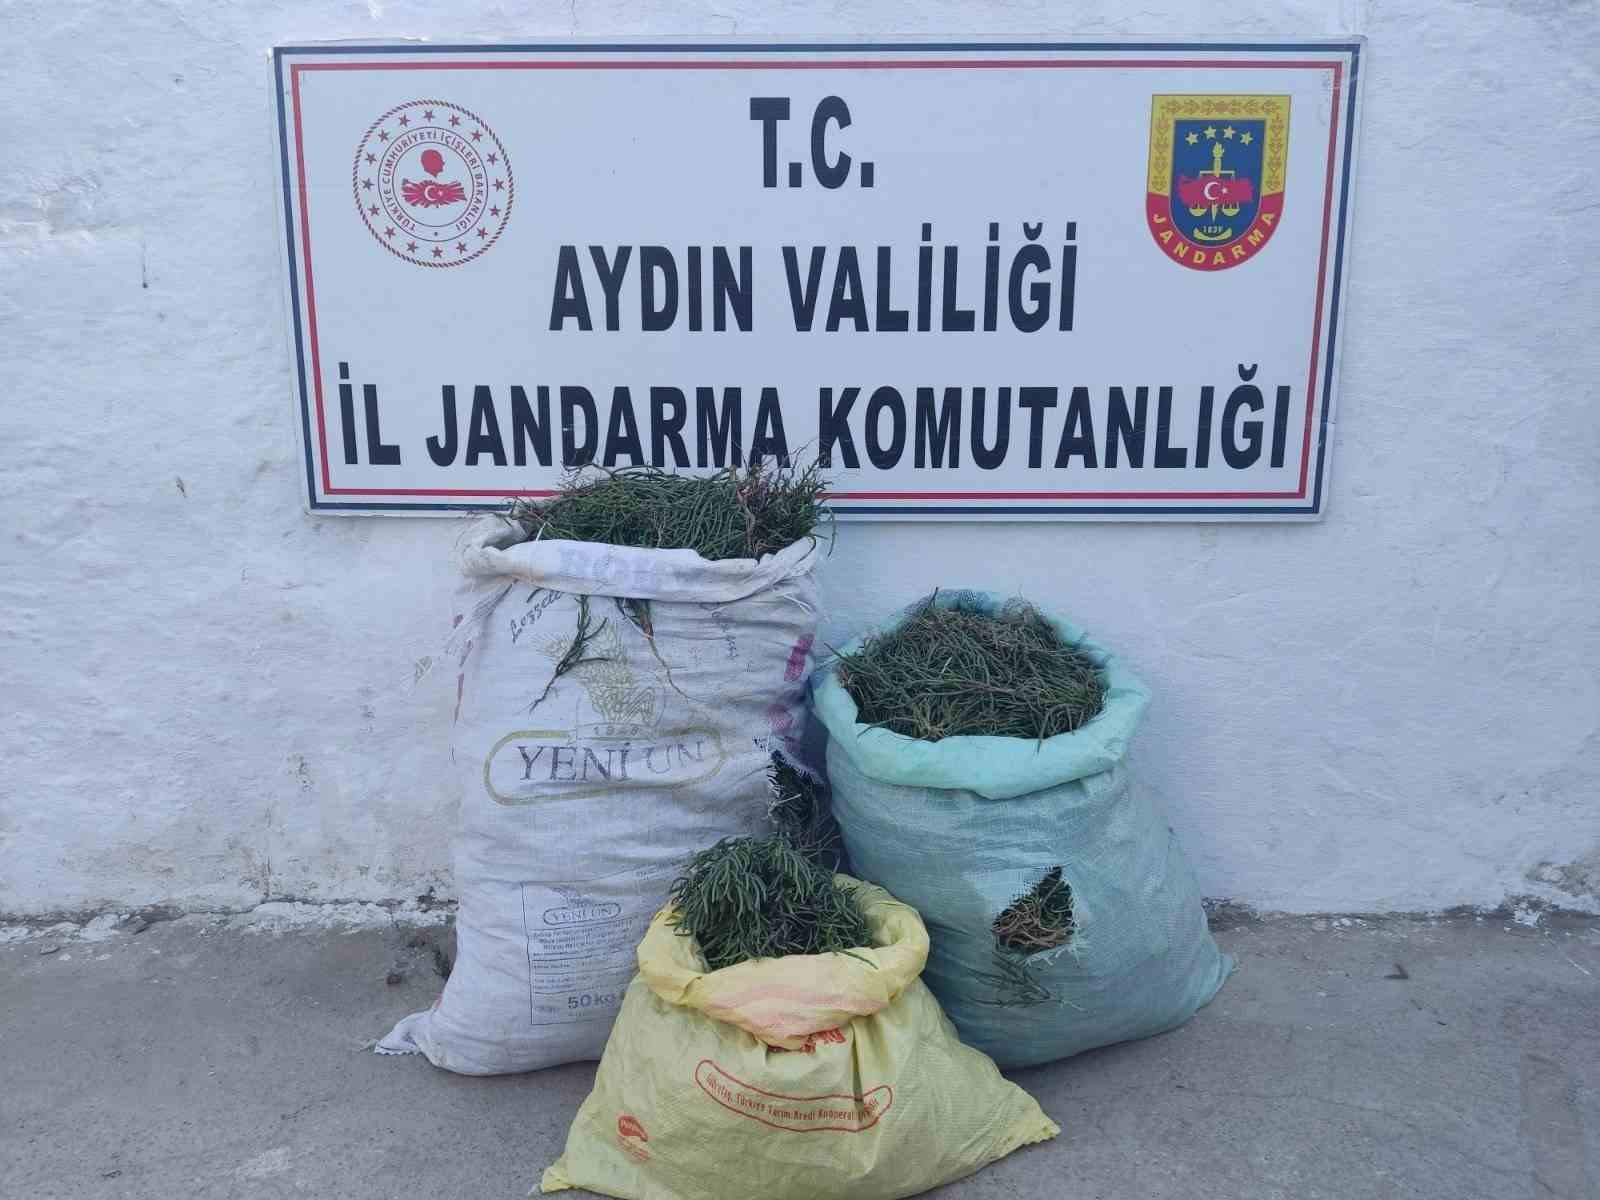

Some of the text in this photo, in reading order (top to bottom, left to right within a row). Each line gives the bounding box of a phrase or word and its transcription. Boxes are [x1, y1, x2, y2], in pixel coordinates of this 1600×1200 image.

[382, 130, 437, 184] CUMHURİYETİ
[750, 96, 875, 189] T.C.
[1153, 211, 1276, 265] JANDARMA
[549, 222, 1077, 332] AYDIN VALİLİĞİ
[338, 362, 1291, 470] İL JANDARMA KOMUTANLIĞI
[568, 994, 592, 1010] 50
